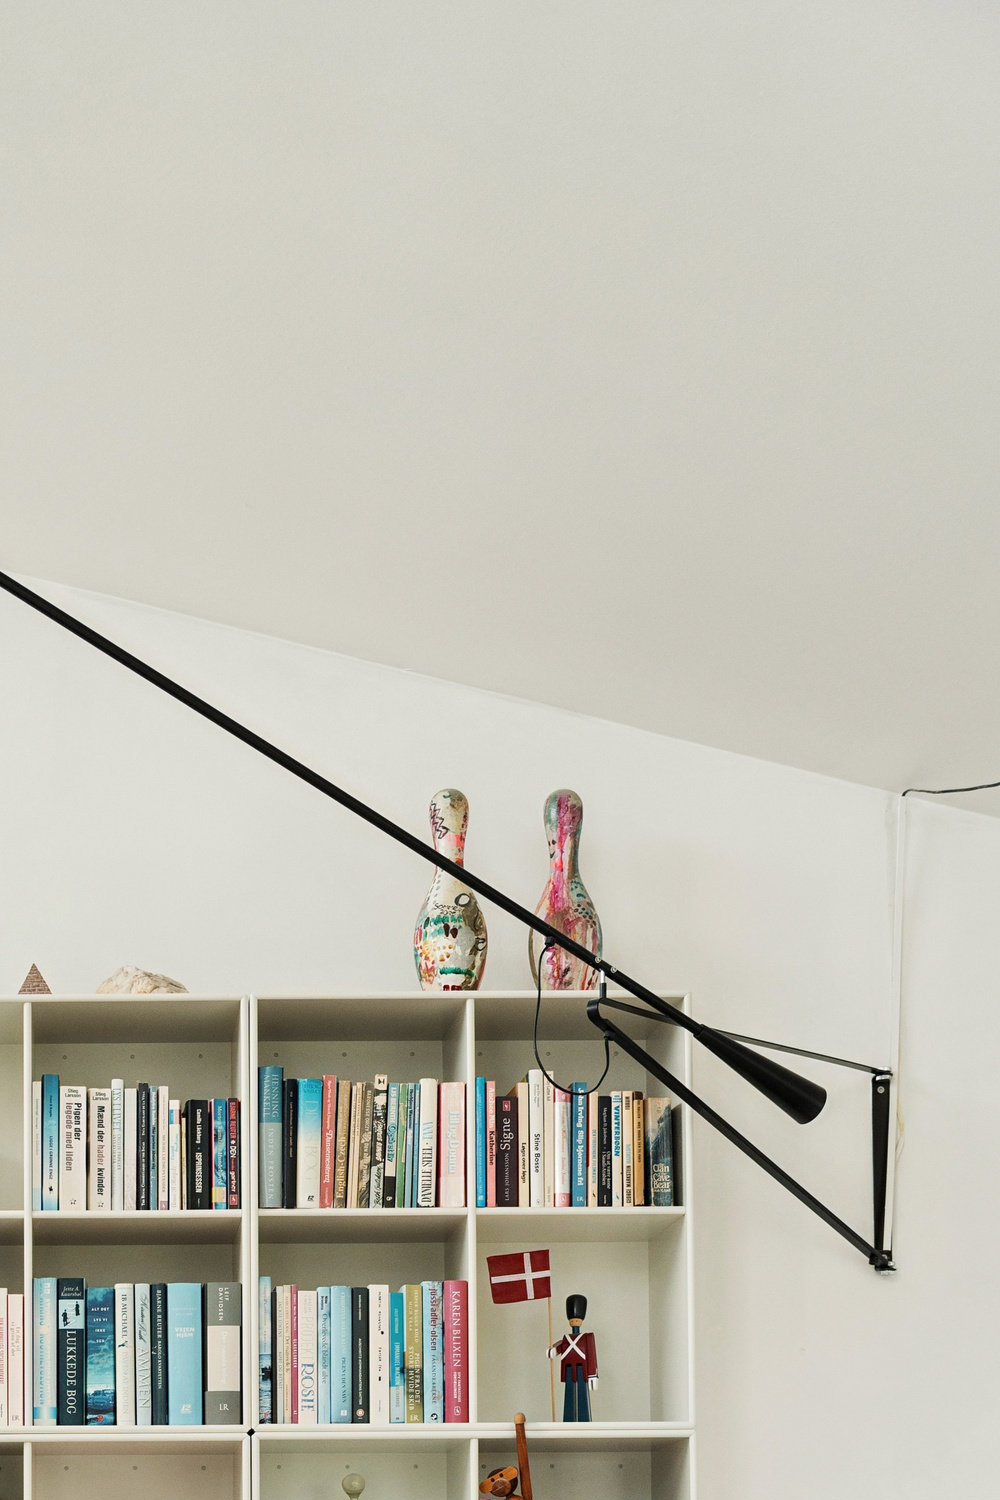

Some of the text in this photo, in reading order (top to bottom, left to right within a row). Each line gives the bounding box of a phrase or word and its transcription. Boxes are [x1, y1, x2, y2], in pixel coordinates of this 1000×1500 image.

[65, 1102, 73, 1129] legede
[73, 1102, 82, 1141] Pigen der
[500, 1118, 514, 1150] Signe
[97, 1106, 105, 1196] Mænd der hader kvinder
[336, 1137, 346, 1198] English-Czech
[653, 1164, 669, 1172] Clan
[653, 1180, 672, 1188] Bear
[429, 1288, 438, 1350] jussi adler-olsen
[452, 1291, 461, 1367] KAREN BLIXEN
[66, 1330, 76, 1414] LUKKEDE BOG
[138, 1348, 150, 1408] AMMEN
[301, 1363, 314, 1411] ROSIE
